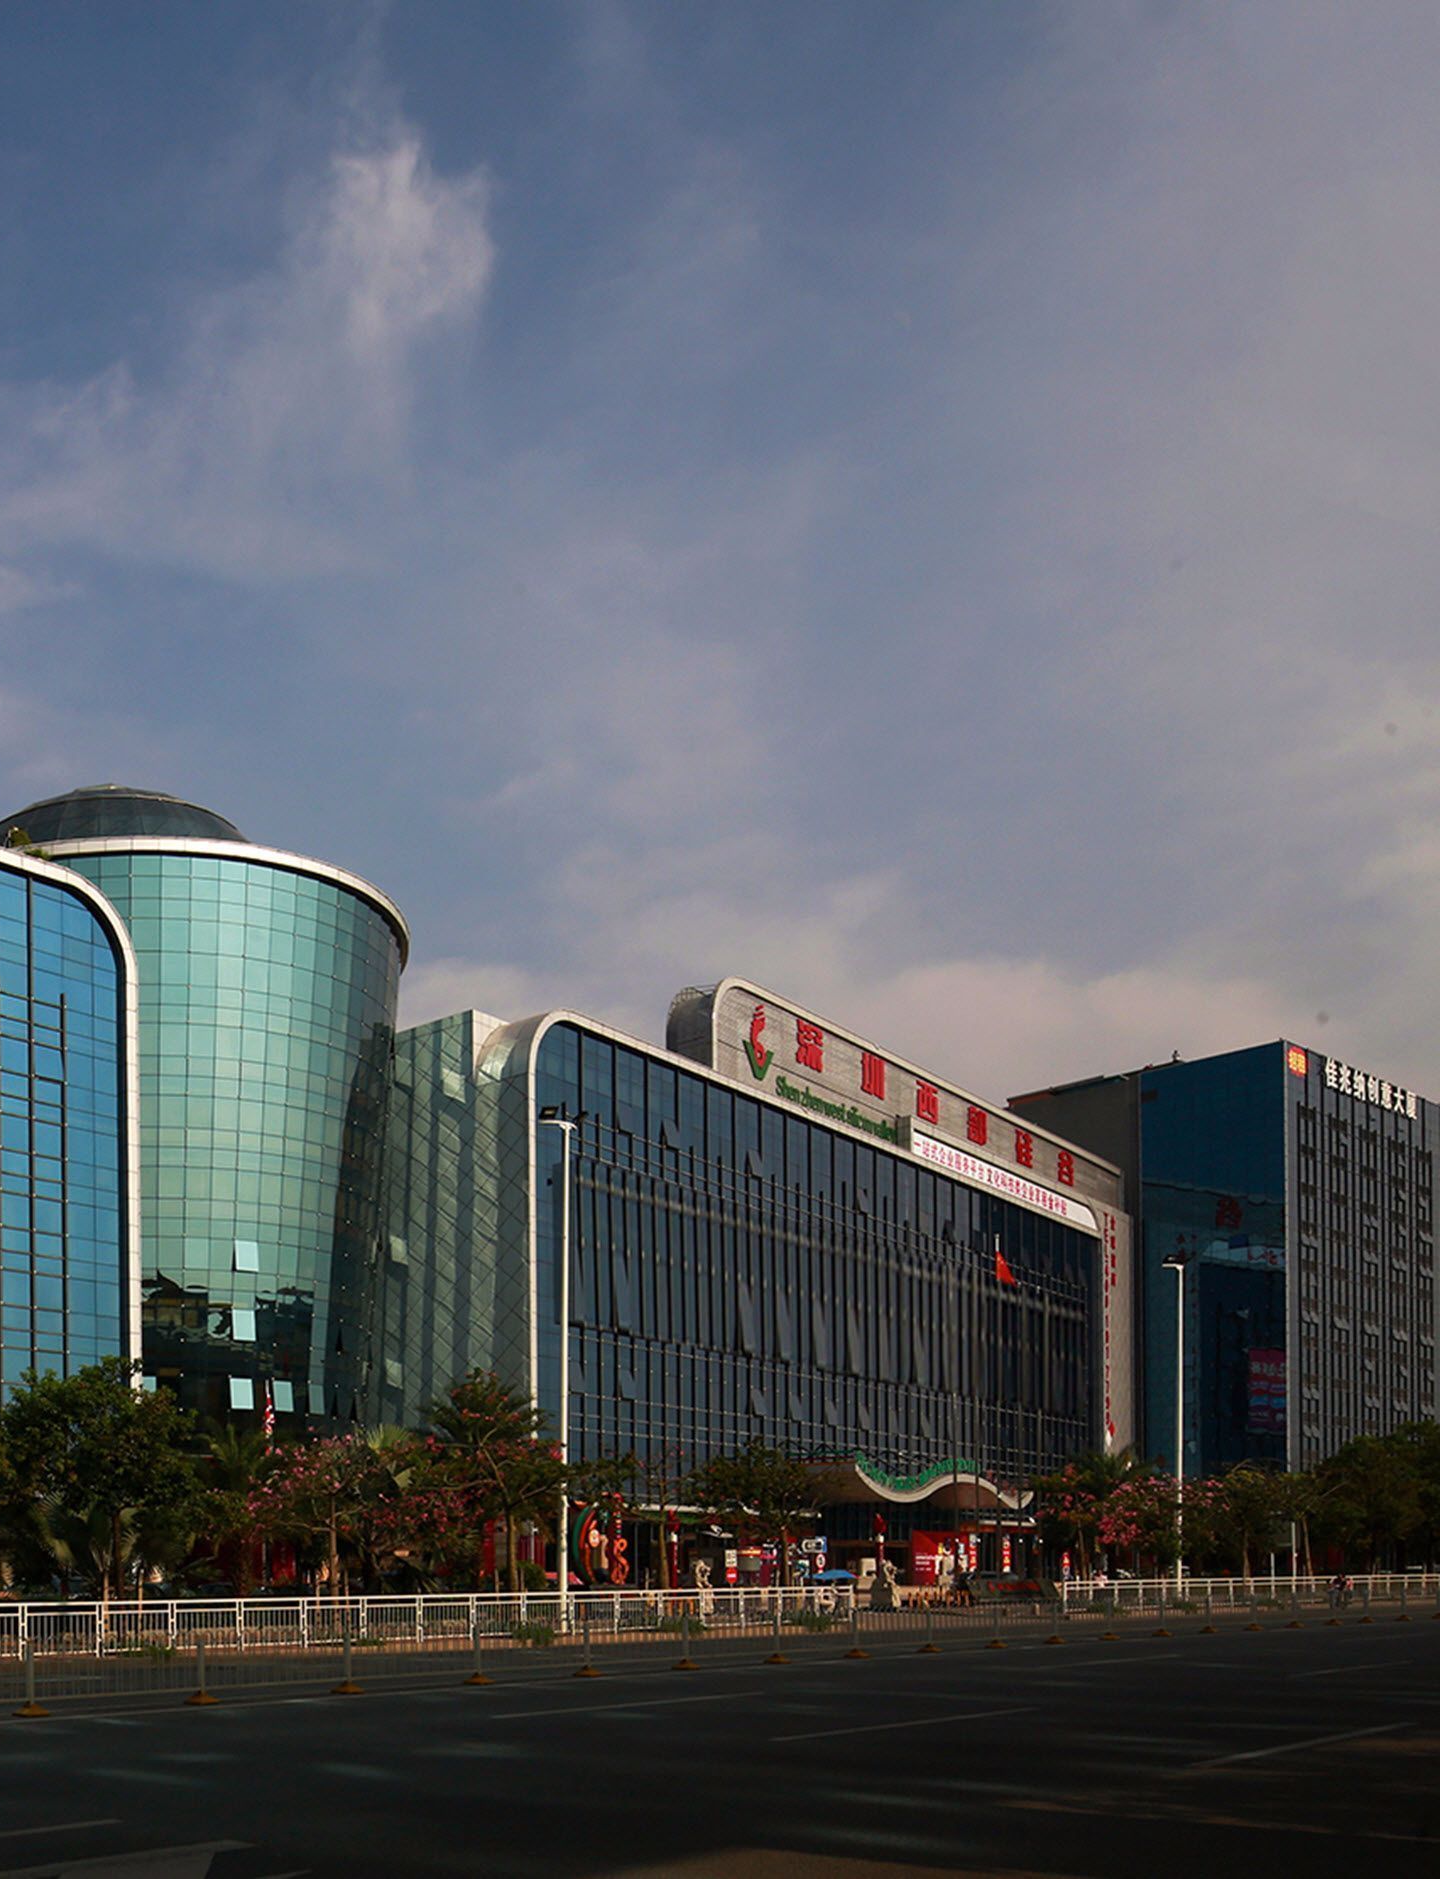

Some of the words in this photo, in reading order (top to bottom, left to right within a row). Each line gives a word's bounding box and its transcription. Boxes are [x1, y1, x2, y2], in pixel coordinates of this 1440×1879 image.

[796, 1018, 1074, 1188] 深圳西部硅谷
